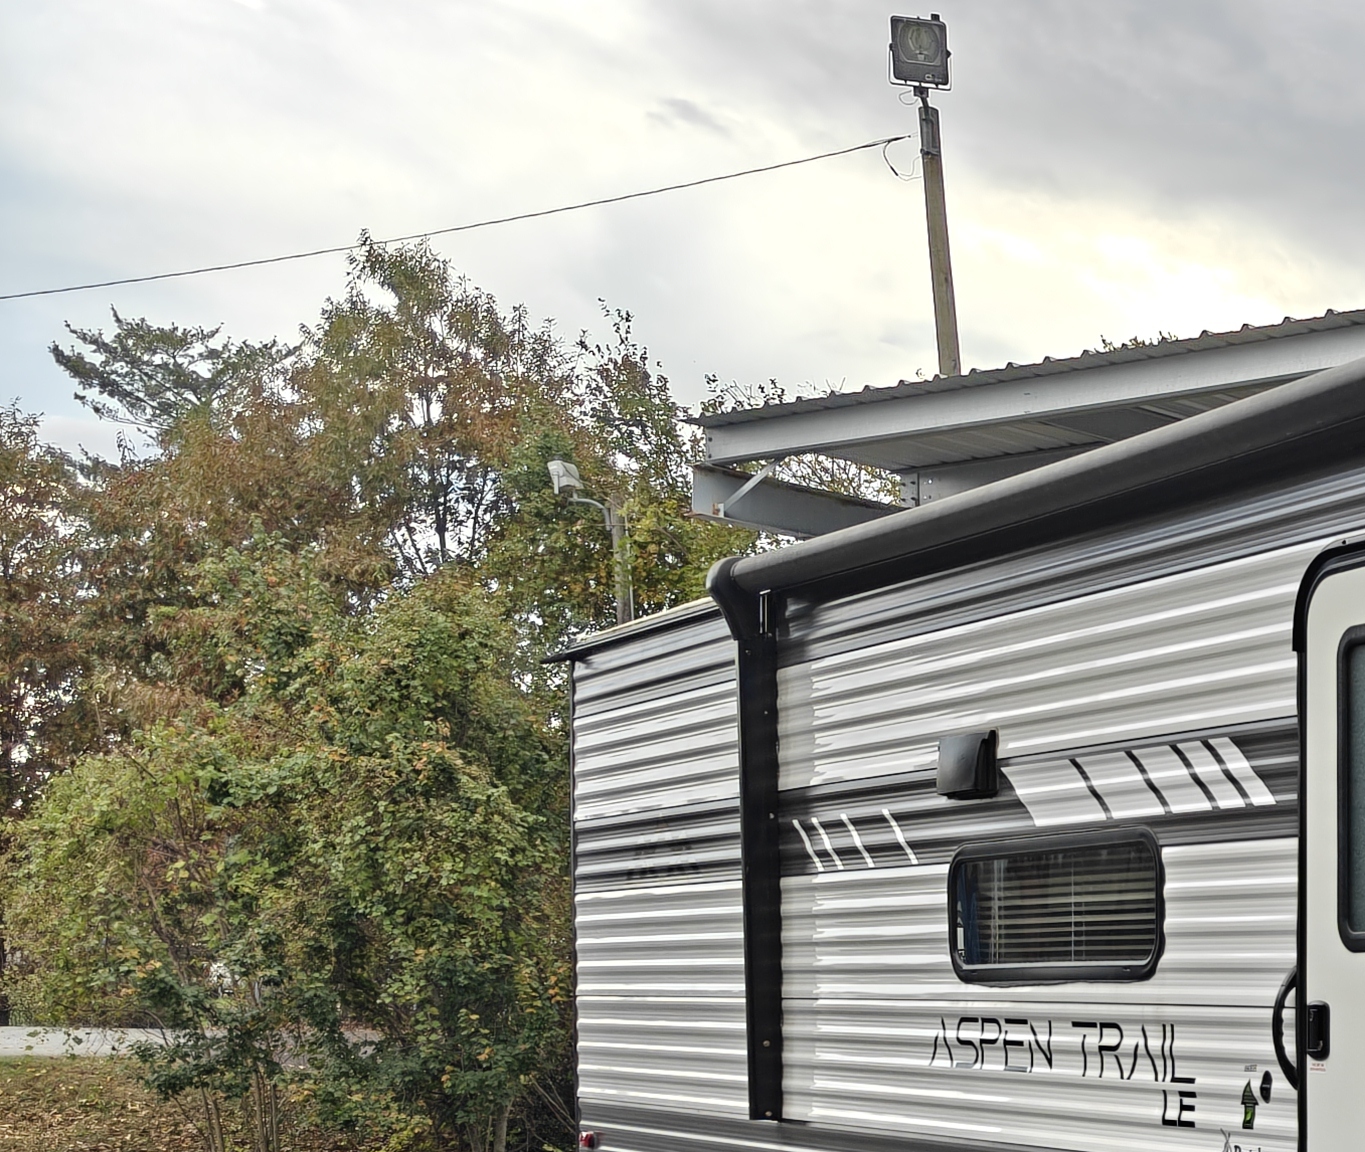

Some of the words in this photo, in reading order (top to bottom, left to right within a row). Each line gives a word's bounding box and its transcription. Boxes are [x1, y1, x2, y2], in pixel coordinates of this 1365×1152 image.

[928, 1016, 1054, 1073] ASPEN
[1071, 1020, 1197, 1084] TRAIL
[1161, 1089, 1198, 1129] LE
